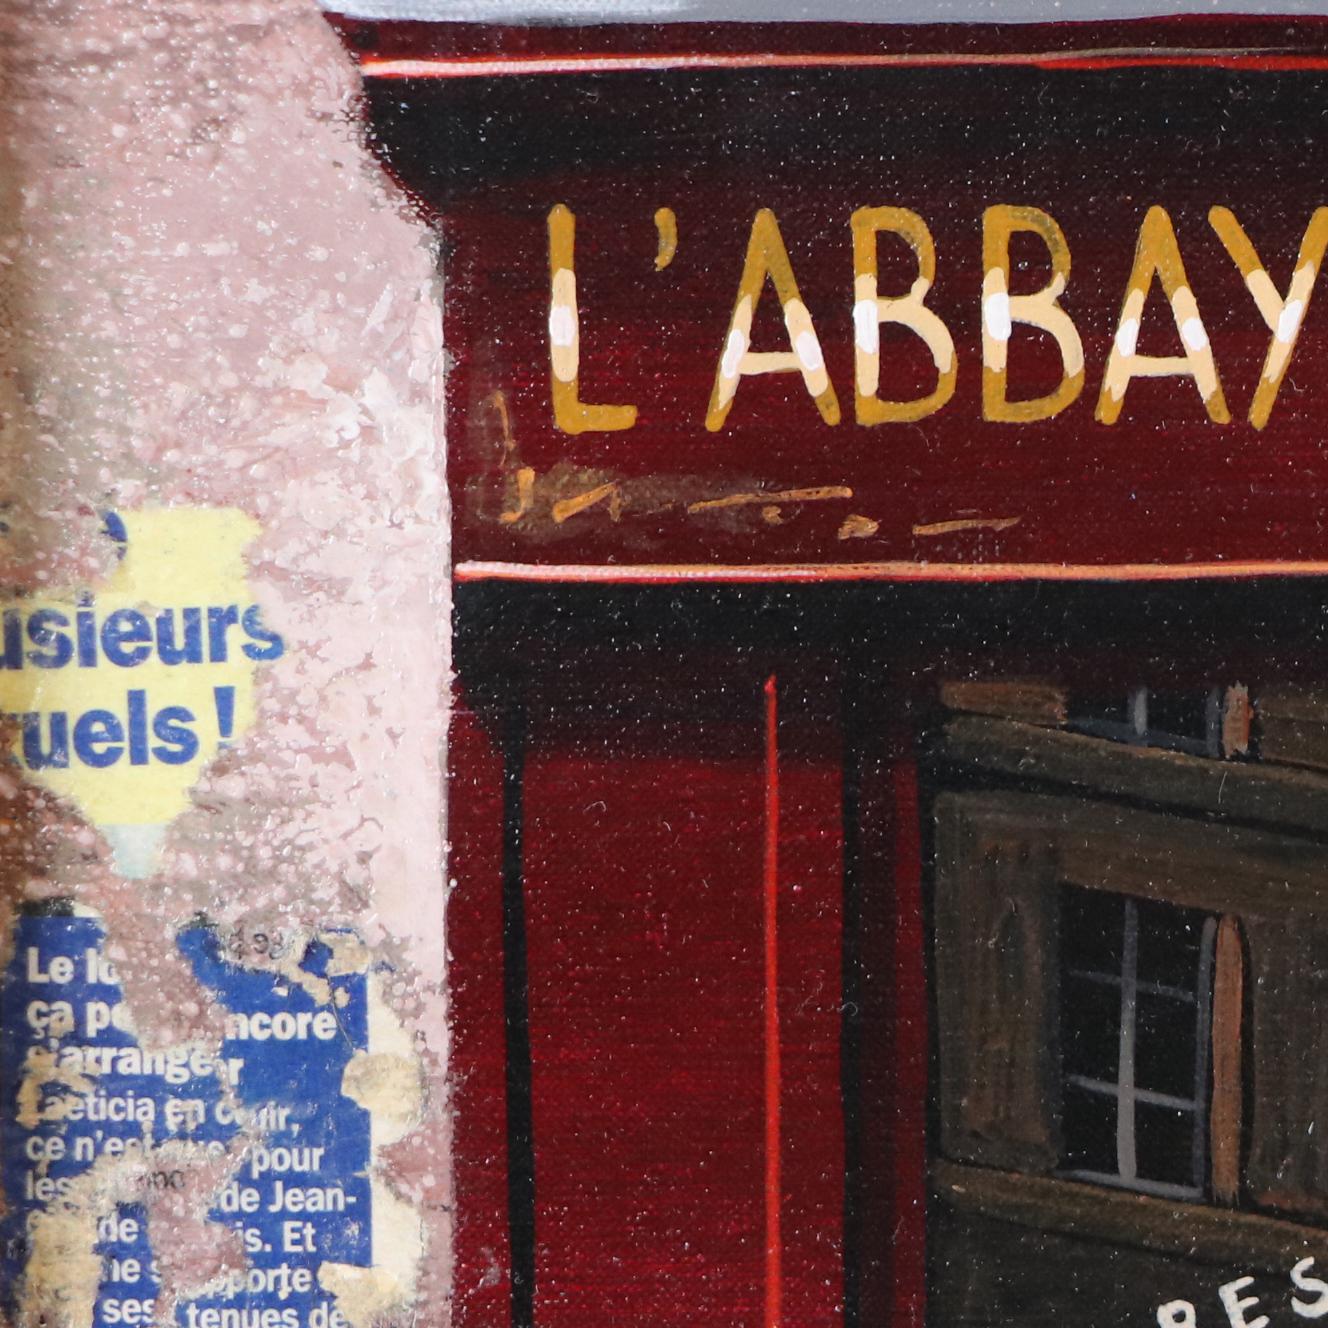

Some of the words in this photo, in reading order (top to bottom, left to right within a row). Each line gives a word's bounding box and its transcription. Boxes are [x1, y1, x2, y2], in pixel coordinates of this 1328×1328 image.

[27, 947, 75, 984] Le
[223, 1011, 338, 1041] ncore
[26, 1134, 66, 1162] ce
[251, 1146, 325, 1180] pour
[219, 1180, 261, 1213] de
[268, 1180, 358, 1213] Jean-
[283, 1220, 318, 1252] Et
